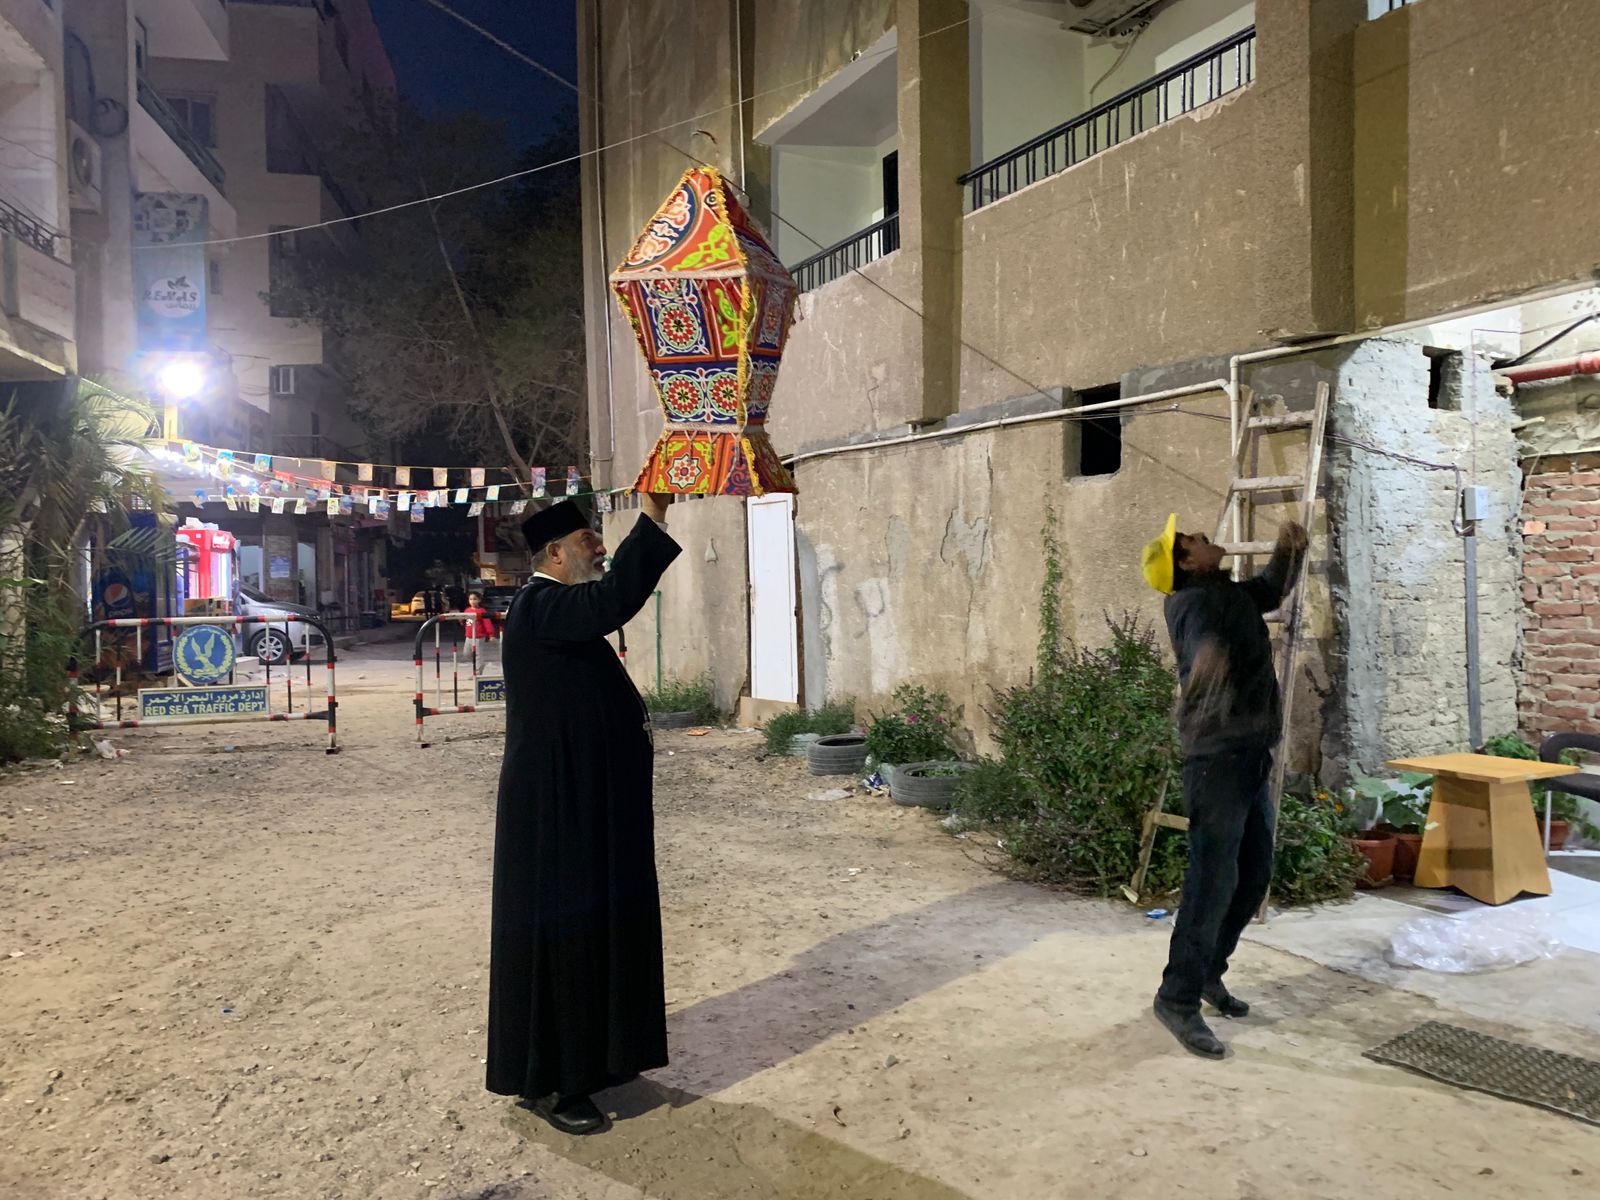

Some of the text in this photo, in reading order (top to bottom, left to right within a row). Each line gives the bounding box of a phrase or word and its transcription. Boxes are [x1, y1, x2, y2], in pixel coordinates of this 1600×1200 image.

[184, 692, 213, 704] البحر
[214, 694, 239, 703] مرور
[480, 691, 497, 701] RED
[145, 701, 266, 716] RED SEA TRAFFIC DEPT.
